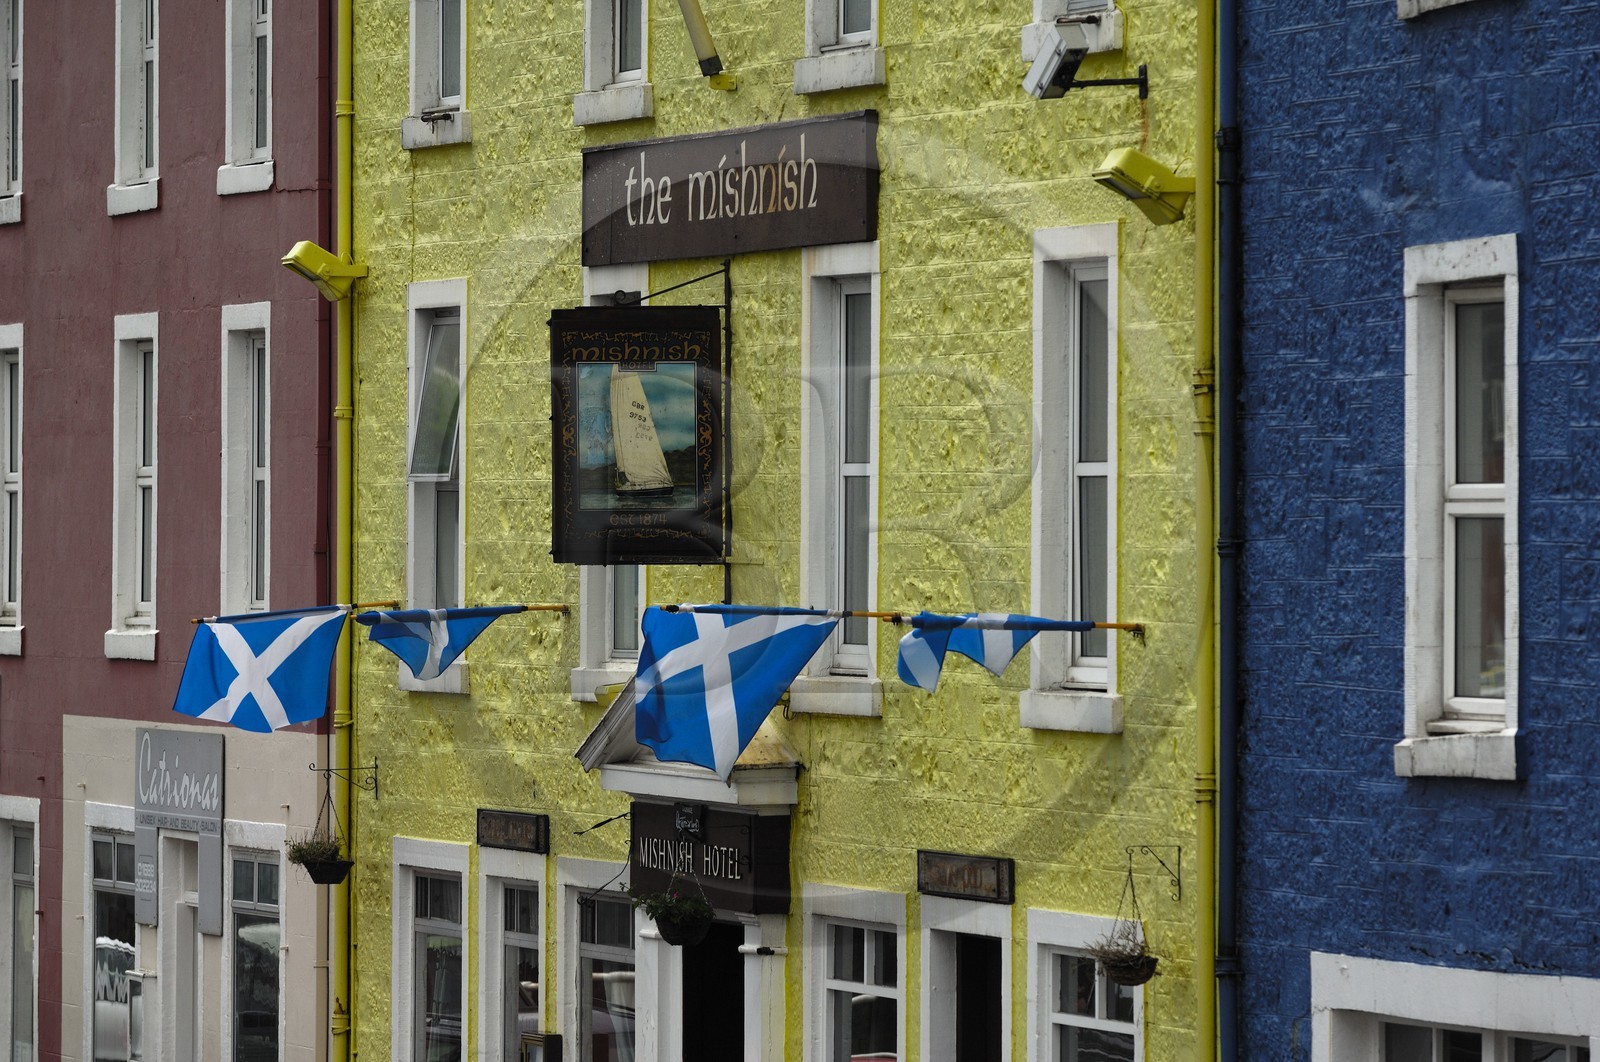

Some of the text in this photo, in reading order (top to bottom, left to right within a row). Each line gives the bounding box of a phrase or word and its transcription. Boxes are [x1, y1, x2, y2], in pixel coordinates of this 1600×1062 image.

[625, 151, 672, 226] the
[572, 340, 701, 361] mishnish
[639, 513, 667, 526] 1874
[170, 817, 179, 828] AND
[180, 818, 199, 830] BEAUTY
[200, 820, 217, 832] SALON
[639, 836, 741, 880] MISHNISH HOTEL
